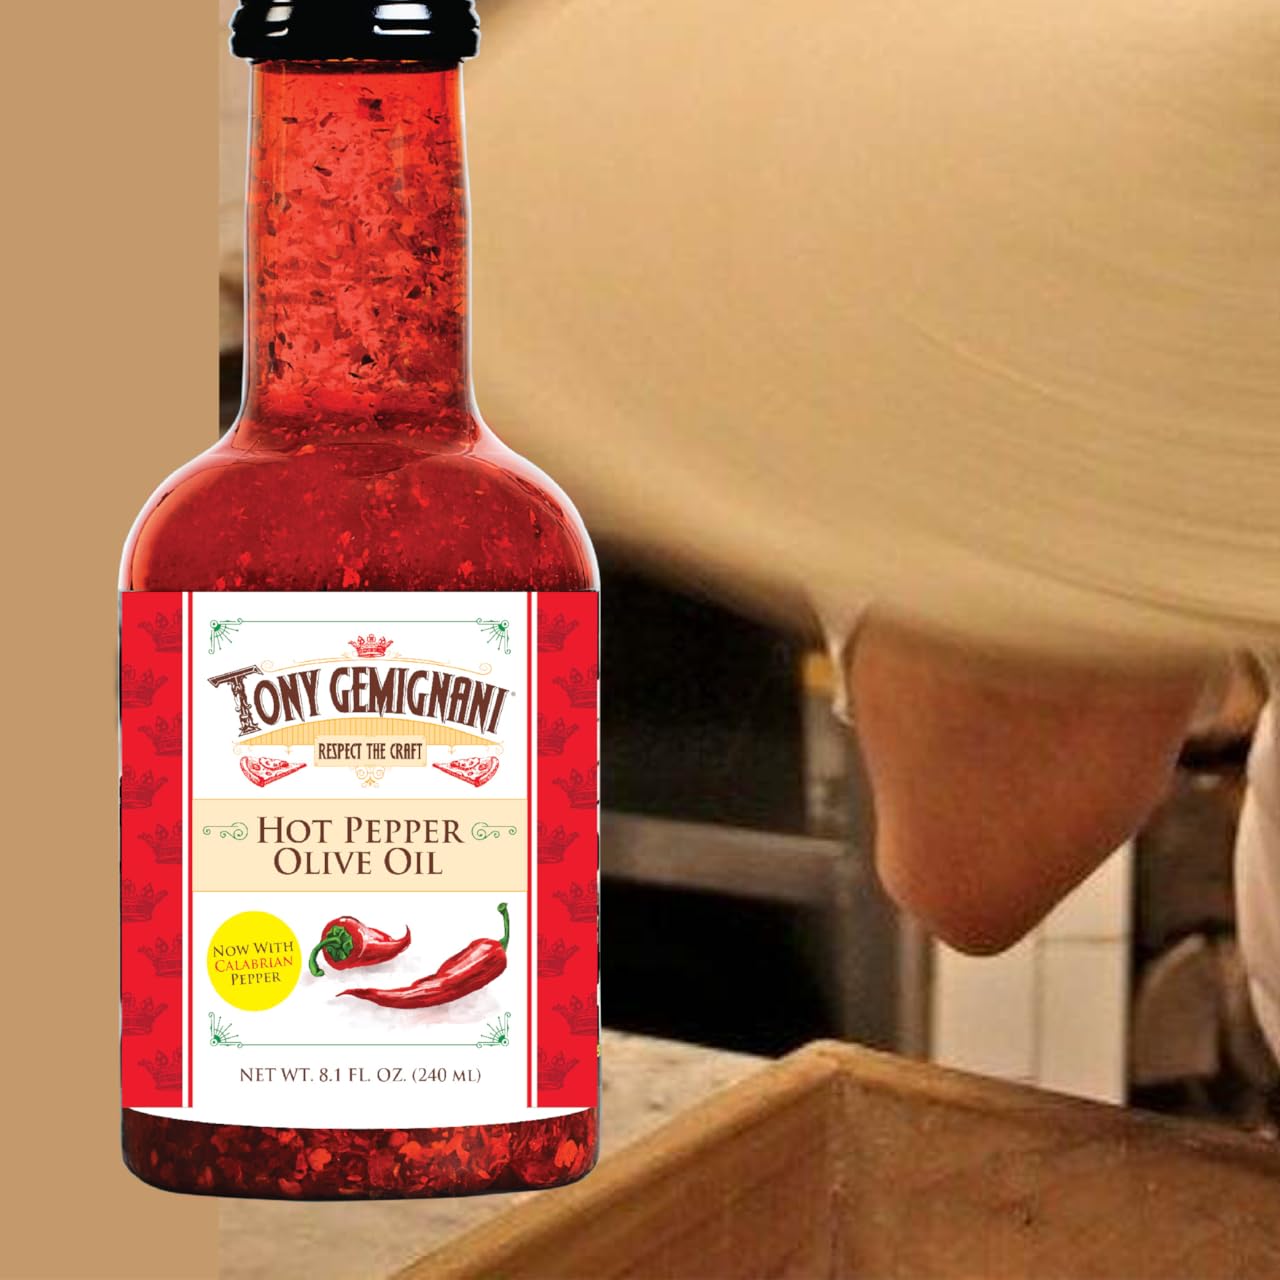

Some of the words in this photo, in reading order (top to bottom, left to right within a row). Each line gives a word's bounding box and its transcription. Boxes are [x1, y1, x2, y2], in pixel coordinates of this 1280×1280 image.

[207, 664, 321, 737] TONY
[329, 666, 510, 735] GEMIGNANI
[318, 742, 362, 760] RESPECT
[366, 742, 386, 760] THE
[389, 742, 423, 760] CRAFT
[257, 816, 333, 844] HOT
[344, 816, 465, 844] PEPPER
[273, 847, 372, 876] OLIVE
[383, 847, 443, 876] OIL
[213, 944, 249, 958] NOW
[253, 940, 294, 954] WITH
[214, 955, 293, 973] CALABRIAN
[231, 971, 282, 986] PEPPER
[240, 1067, 276, 1082] NET
[280, 1067, 314, 1082] WT.
[319, 1067, 341, 1083] 8.1
[349, 1067, 371, 1082] FL.
[376, 1067, 407, 1083] OZ.
[411, 1067, 447, 1084] (240
